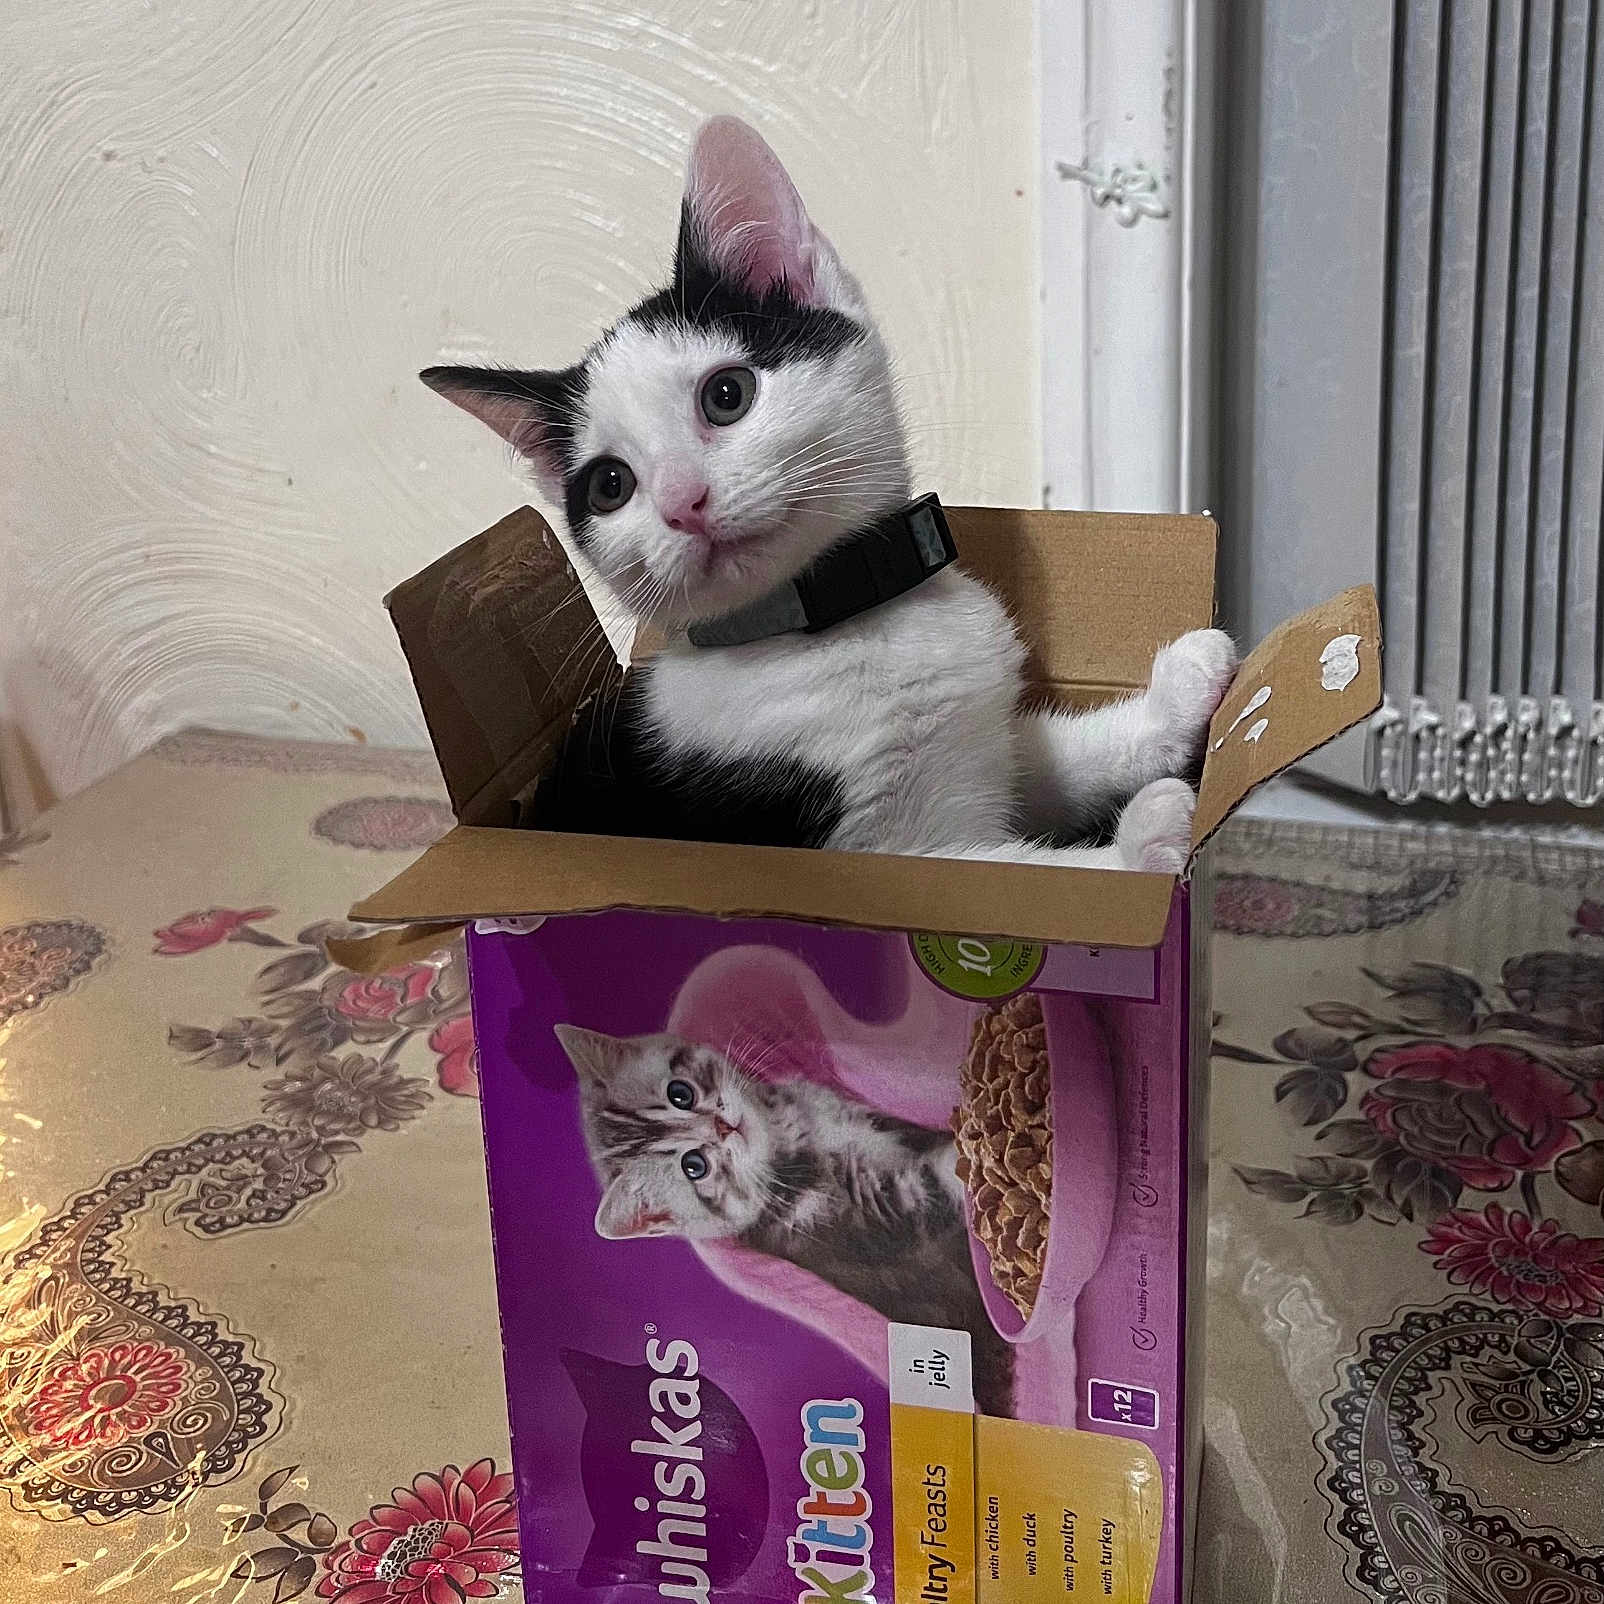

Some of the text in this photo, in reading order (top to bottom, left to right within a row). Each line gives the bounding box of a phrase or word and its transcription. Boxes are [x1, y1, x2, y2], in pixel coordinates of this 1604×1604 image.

[1139, 1111, 1148, 1148] Natural
[1137, 1251, 1149, 1323] Healthy Growth
[908, 1358, 925, 1374] in
[928, 1349, 951, 1390] jelly
[1113, 1389, 1133, 1422] x12
[630, 1337, 712, 1604] whiskas
[787, 1397, 876, 1604] Kitten
[920, 1463, 956, 1604] ltry Feasts
[984, 1496, 1000, 1580] with chicken
[1022, 1512, 1037, 1577] with duck
[1059, 1508, 1079, 1592] with poultry
[1097, 1518, 1116, 1595] with turkey
